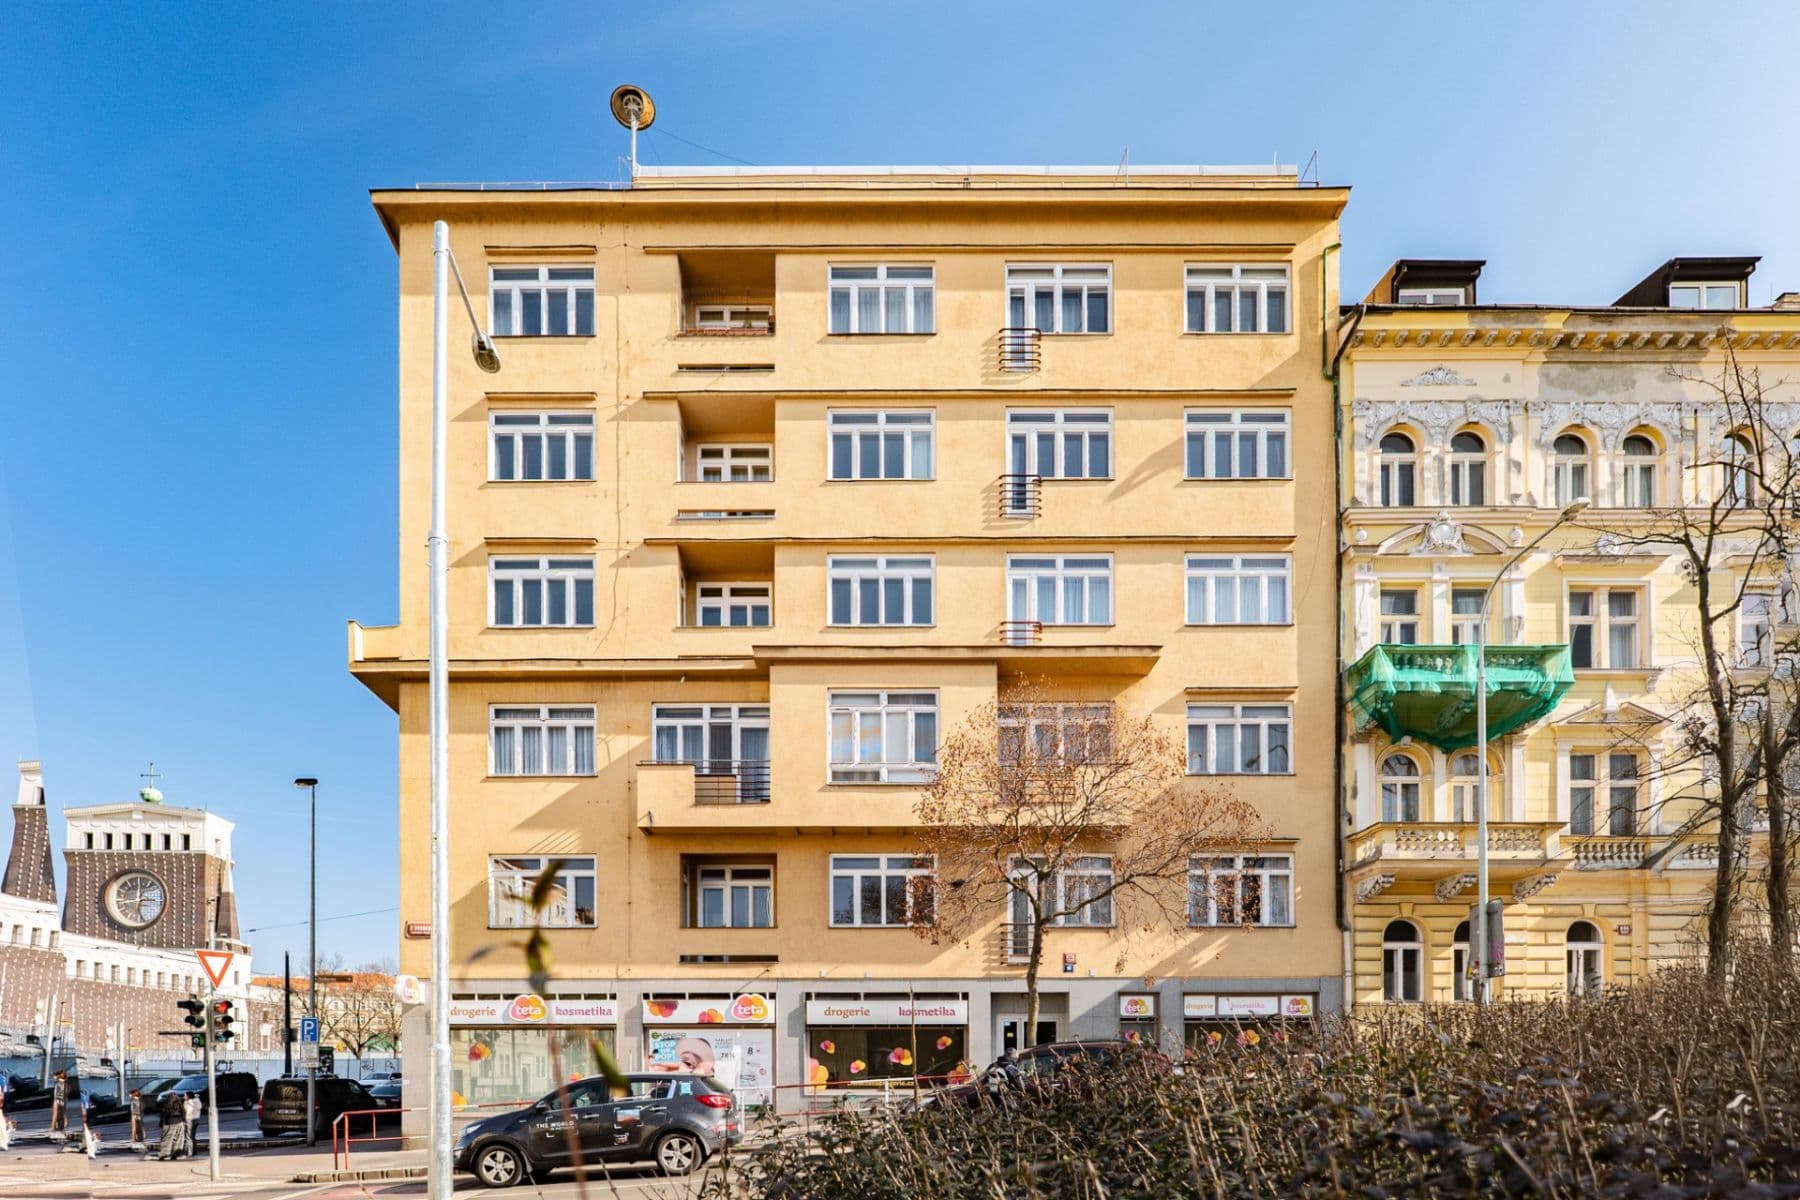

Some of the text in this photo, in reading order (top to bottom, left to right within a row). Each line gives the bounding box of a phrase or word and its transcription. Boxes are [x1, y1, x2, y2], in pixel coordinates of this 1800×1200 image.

[450, 1006, 496, 1018] drogerie
[515, 1005, 541, 1015] teta
[555, 1006, 613, 1016] kosmetika
[738, 1005, 764, 1015] teta
[824, 1006, 870, 1018] drogerie
[898, 1006, 956, 1016] kosmetika
[1127, 1004, 1147, 1012] teta
[1289, 1003, 1308, 1012] teta
[654, 1041, 676, 1049] STOP
